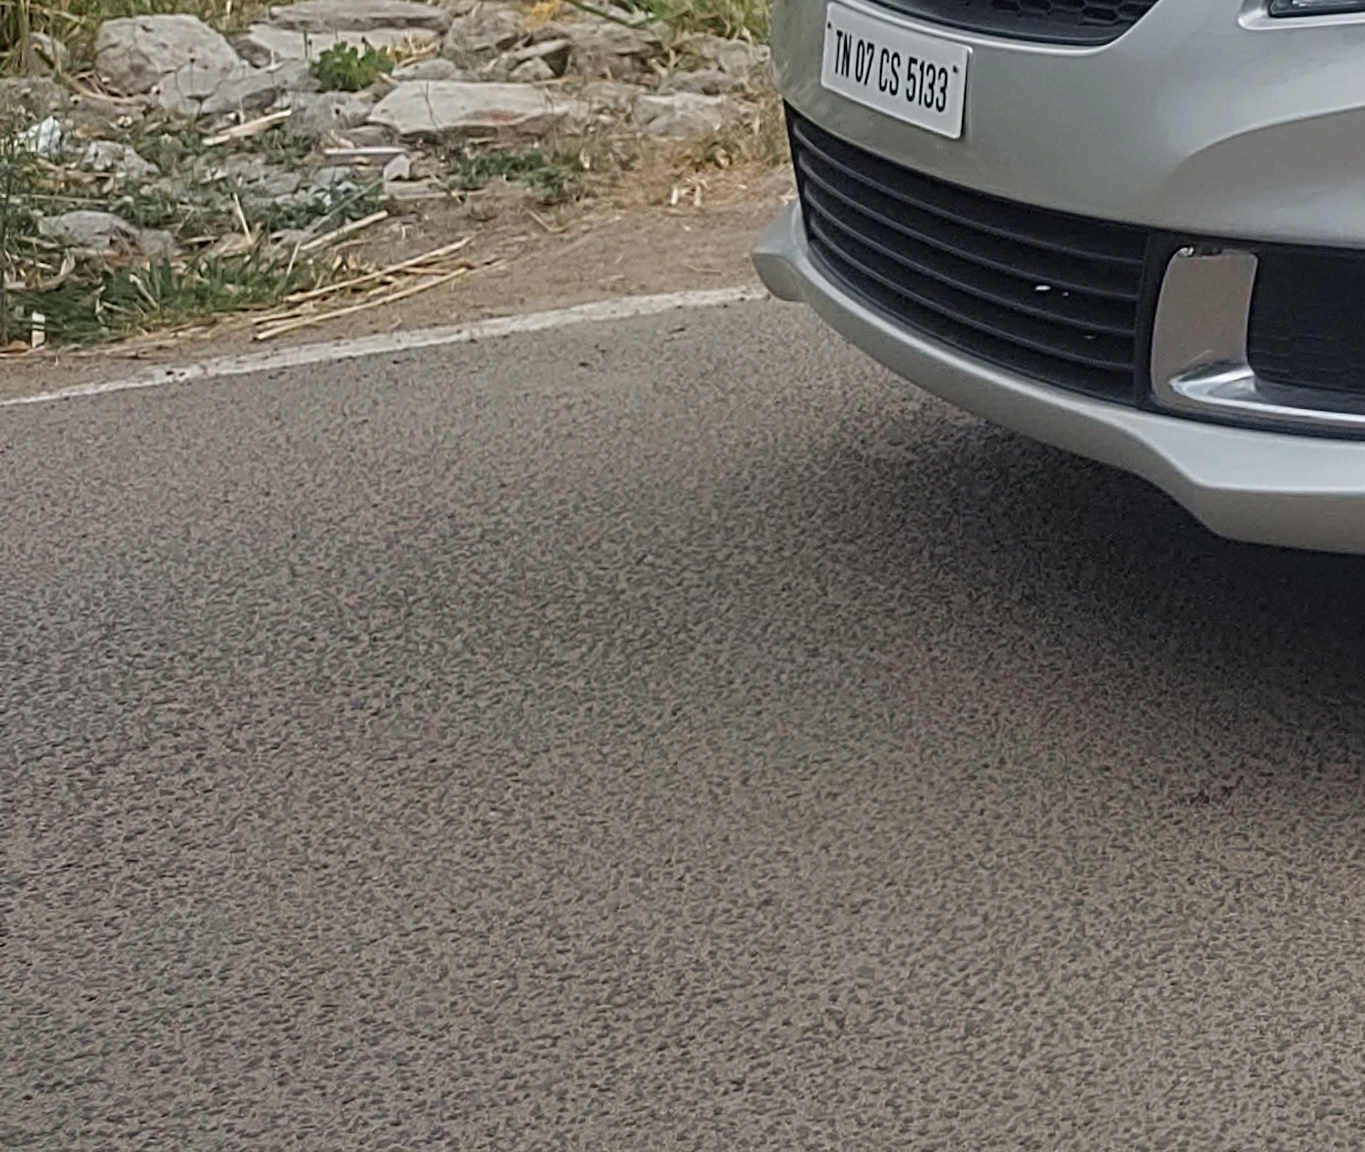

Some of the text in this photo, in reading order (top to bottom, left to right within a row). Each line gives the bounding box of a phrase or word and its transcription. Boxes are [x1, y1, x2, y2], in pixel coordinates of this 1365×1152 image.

[836, 30, 948, 113] TN 07 CS 5133
